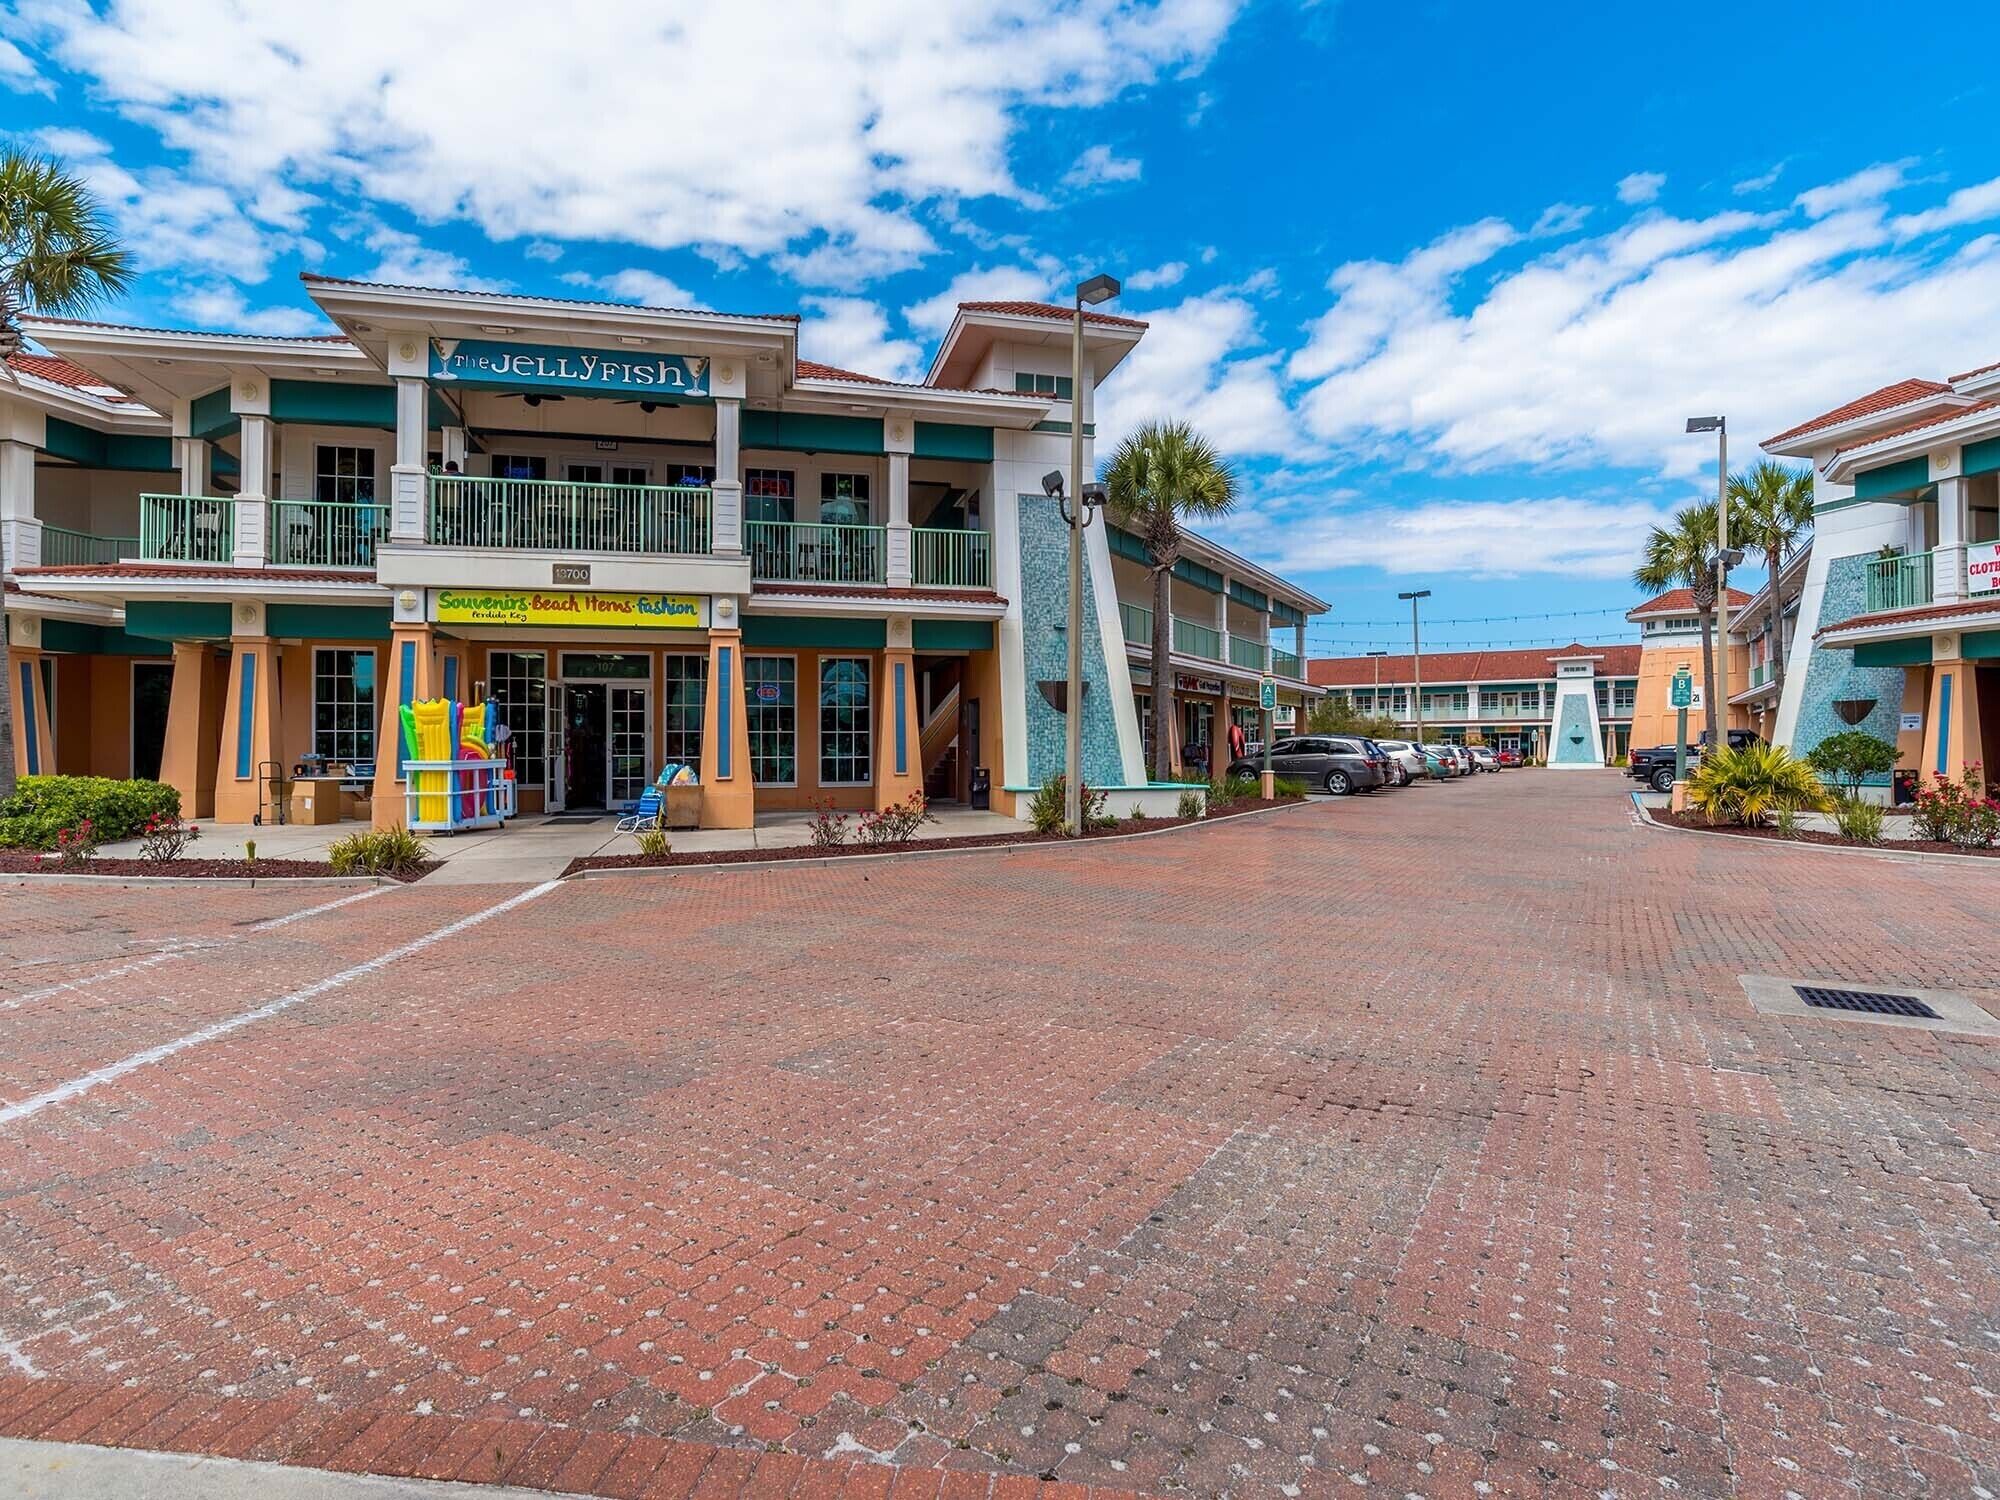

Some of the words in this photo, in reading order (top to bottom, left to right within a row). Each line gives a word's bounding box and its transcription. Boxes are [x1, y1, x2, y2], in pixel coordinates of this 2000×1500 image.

[454, 354, 489, 369] The
[752, 479, 788, 496] OPEN
[439, 590, 529, 611] Souvenirs
[531, 593, 581, 612] Beach
[585, 594, 632, 613] Items
[471, 610, 507, 619] Perdido
[509, 611, 527, 623] Key
[597, 662, 615, 673] 107
[1264, 685, 1272, 694] A
[1678, 679, 1686, 689] B
